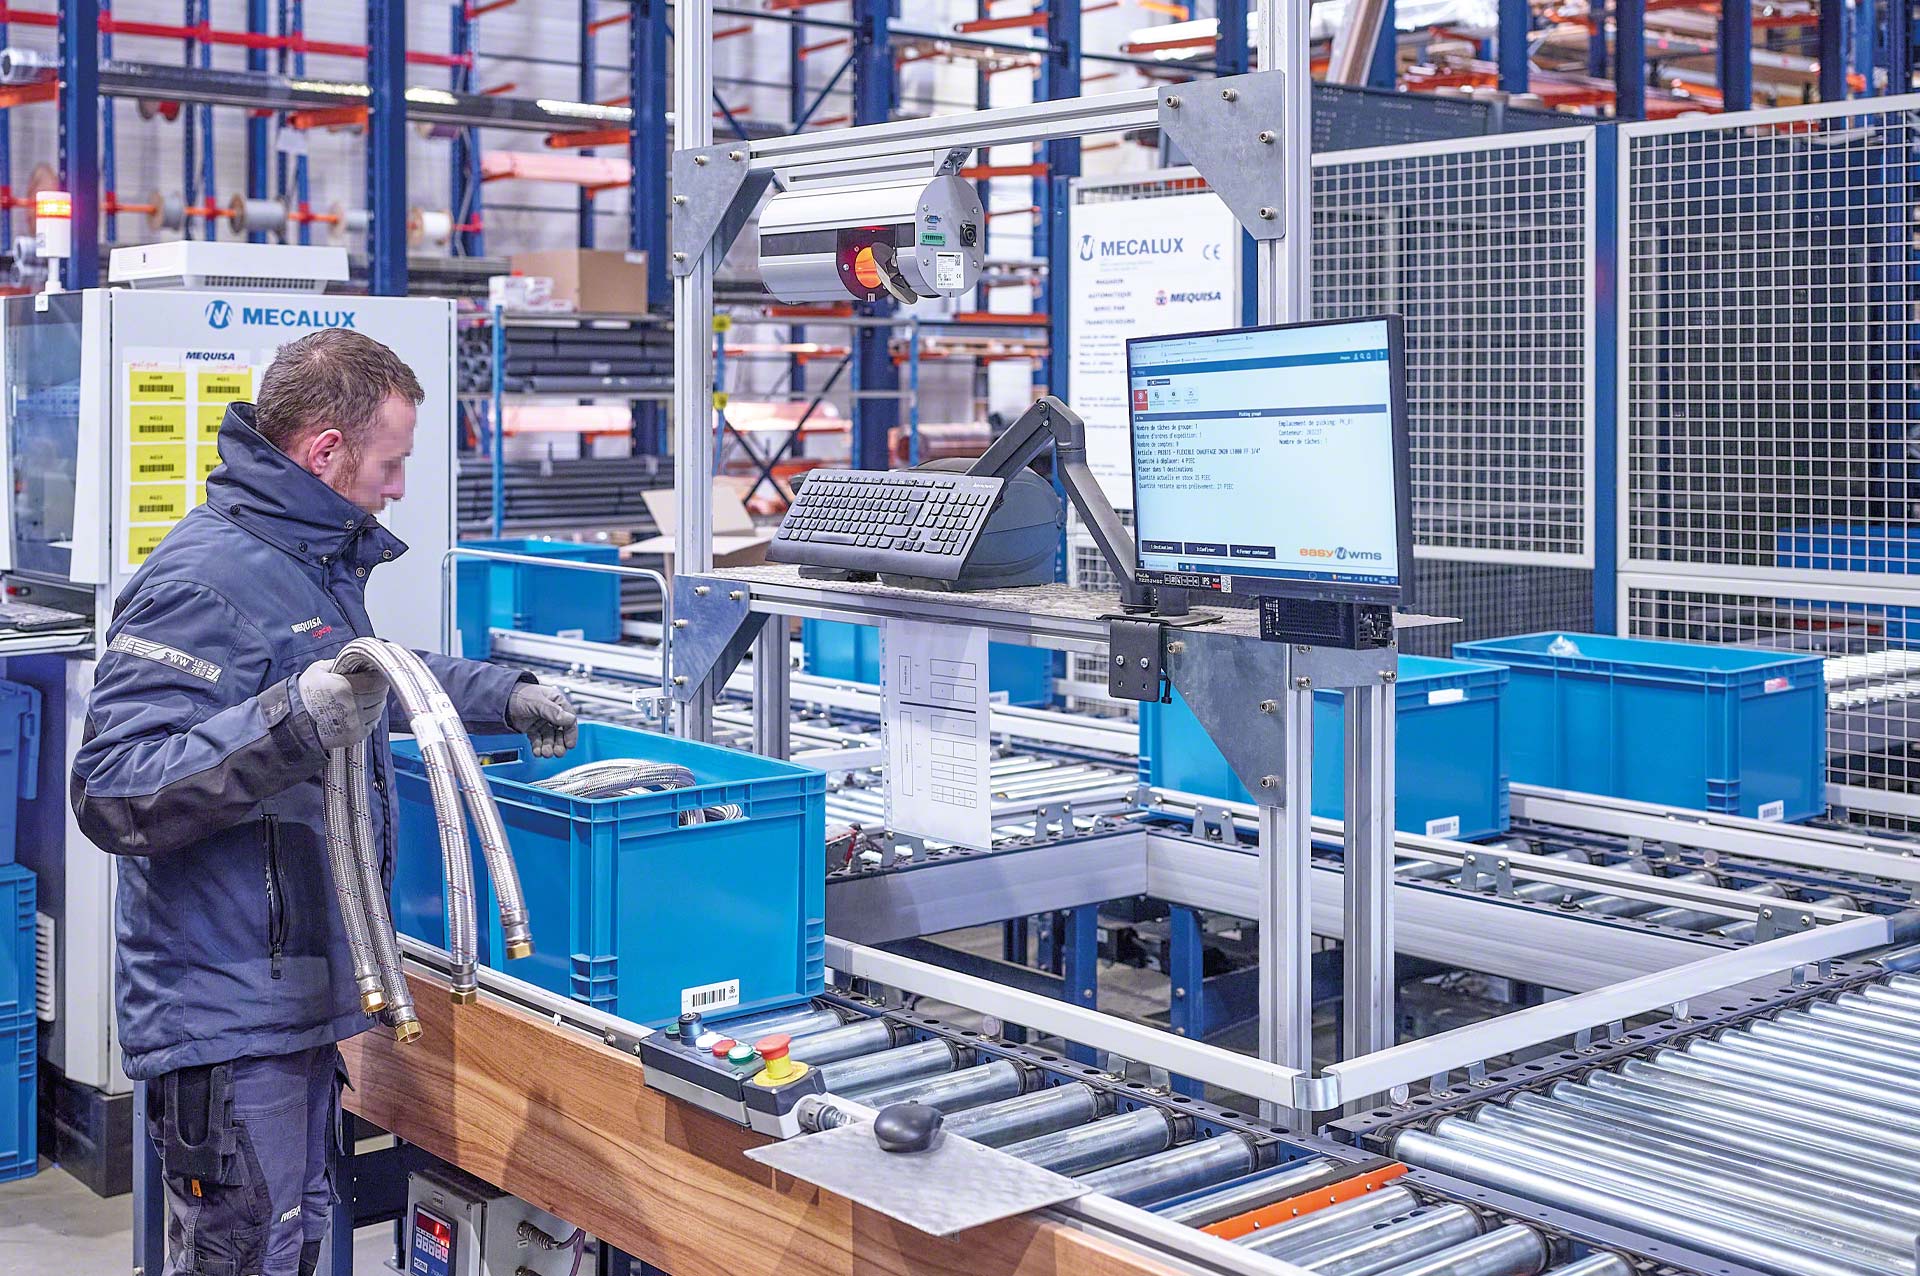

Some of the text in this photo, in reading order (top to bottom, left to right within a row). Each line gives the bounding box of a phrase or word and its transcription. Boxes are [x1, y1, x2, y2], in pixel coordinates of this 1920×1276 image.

[1101, 238, 1184, 257] MECALUX
[1170, 291, 1222, 304] MEQUISA
[242, 308, 356, 328] MECALUX
[185, 351, 236, 361] MEQUISA
[1299, 547, 1382, 561] easy wms
[291, 616, 323, 634] MEQUISA
[193, 659, 204, 668] 19
[191, 666, 201, 675] 75
